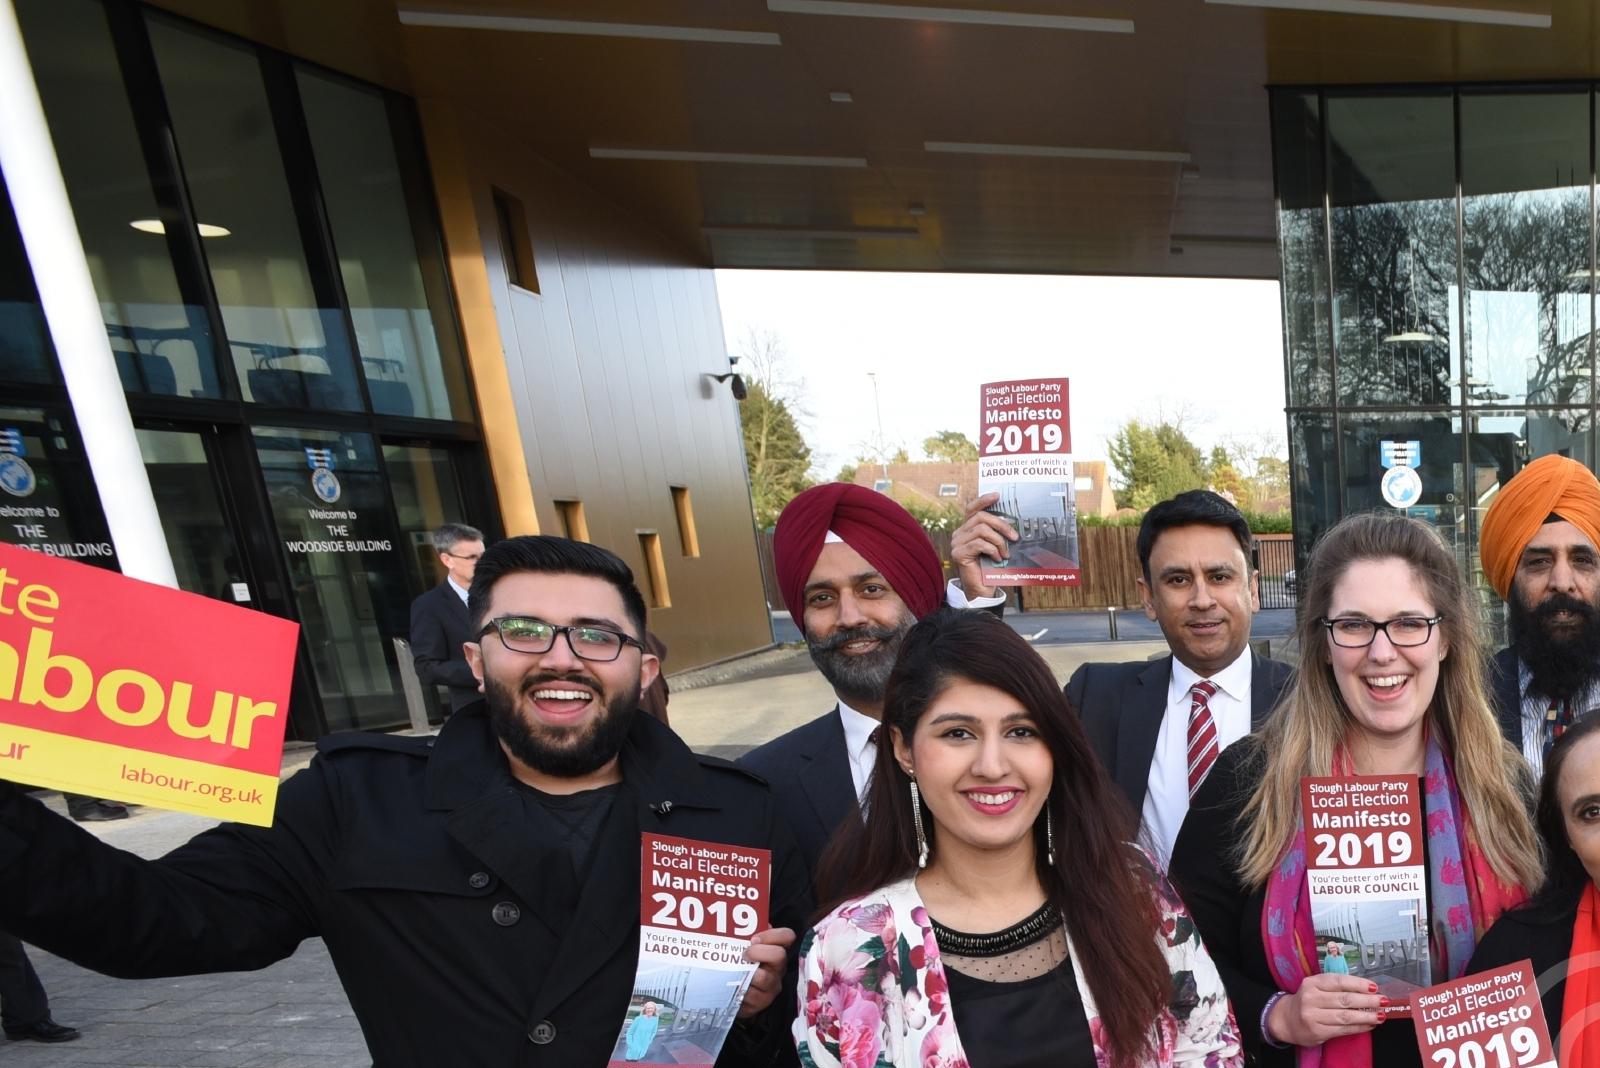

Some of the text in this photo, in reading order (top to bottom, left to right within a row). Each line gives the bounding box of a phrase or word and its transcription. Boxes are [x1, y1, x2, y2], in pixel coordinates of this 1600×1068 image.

[986, 386, 1009, 395] Slough
[1041, 384, 1060, 392] Party
[986, 392, 1060, 407] Local Election
[986, 407, 1061, 423] Manifesto
[986, 424, 1062, 453] 2019
[981, 467, 1068, 477] LABOUR COUNCIL
[0, 505, 59, 517] elcome to
[309, 509, 357, 519] Welcome to
[13, 524, 47, 538] THE
[326, 525, 349, 536] THE
[43, 543, 113, 556] BUILDING
[286, 540, 391, 552] WOODSIDE BUILDING
[0, 568, 59, 623] te
[0, 627, 277, 749] bour
[121, 764, 263, 804] labour.org.uk
[1310, 782, 1408, 794] Slough Labour Party
[1311, 793, 1408, 808] Local Election
[1312, 811, 1410, 829] Manifesto
[652, 841, 759, 867] Slough Labour Party
[1314, 831, 1412, 866] 2019
[653, 853, 758, 879] Local Election
[652, 870, 759, 900] Manifesto
[1312, 874, 1339, 883] You're
[1342, 874, 1370, 882] better
[1373, 873, 1386, 881] off
[1389, 872, 1409, 880] with
[1313, 882, 1419, 895] LABOUR COUNCIL
[652, 892, 758, 936] 2019
[646, 932, 728, 950] You're better off
[645, 943, 755, 965] LABOUR COUN
[1419, 970, 1522, 1007] Slough Labour Party
[1423, 984, 1526, 1022] Local Election
[1426, 1005, 1532, 1046] Manifesto
